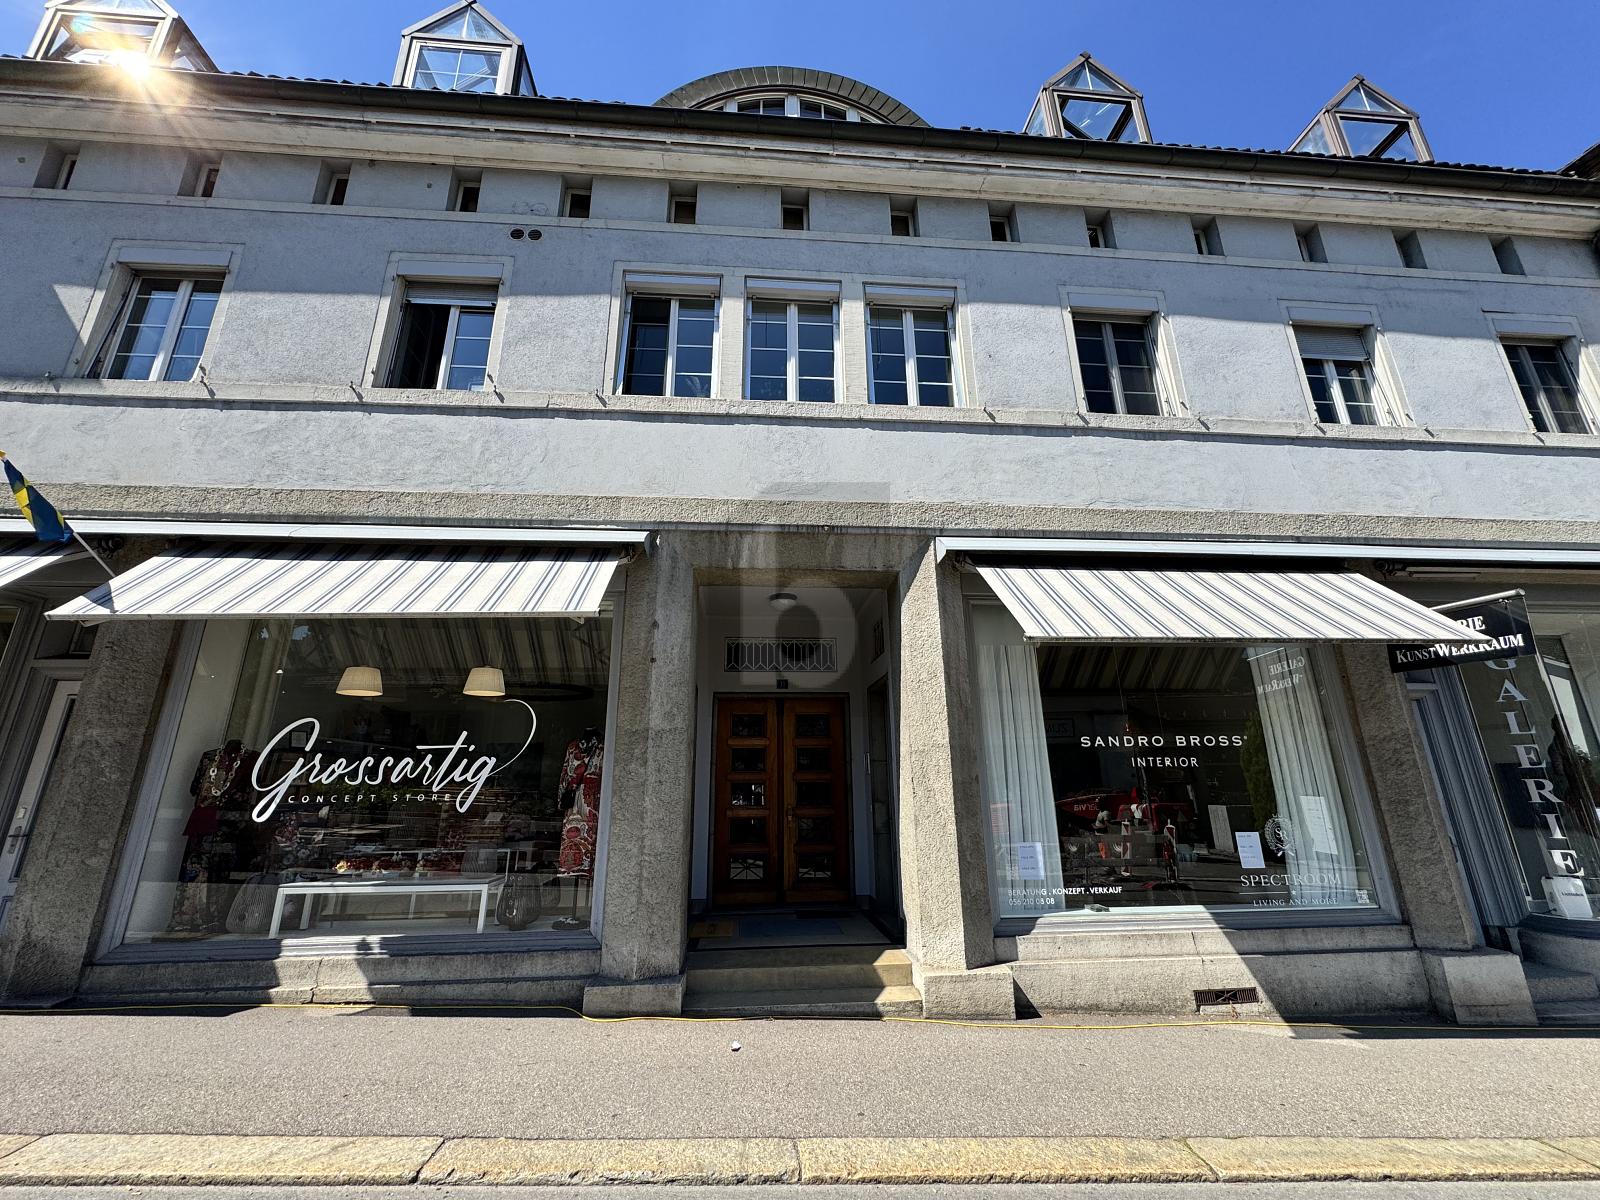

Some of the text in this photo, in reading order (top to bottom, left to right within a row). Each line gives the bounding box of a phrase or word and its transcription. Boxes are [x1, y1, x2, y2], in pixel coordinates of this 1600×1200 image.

[1080, 735, 1164, 747] SANDRO
[252, 699, 536, 822] Grossartig
[1131, 757, 1199, 768] INTERIOR
[288, 793, 451, 804] CONCEPT STORE
[1241, 874, 1341, 886] SPECTROOM
[1052, 887, 1085, 895] KONZEPT
[1090, 886, 1122, 894] VERKAUF
[1253, 897, 1339, 907] LIVING AND MORE
